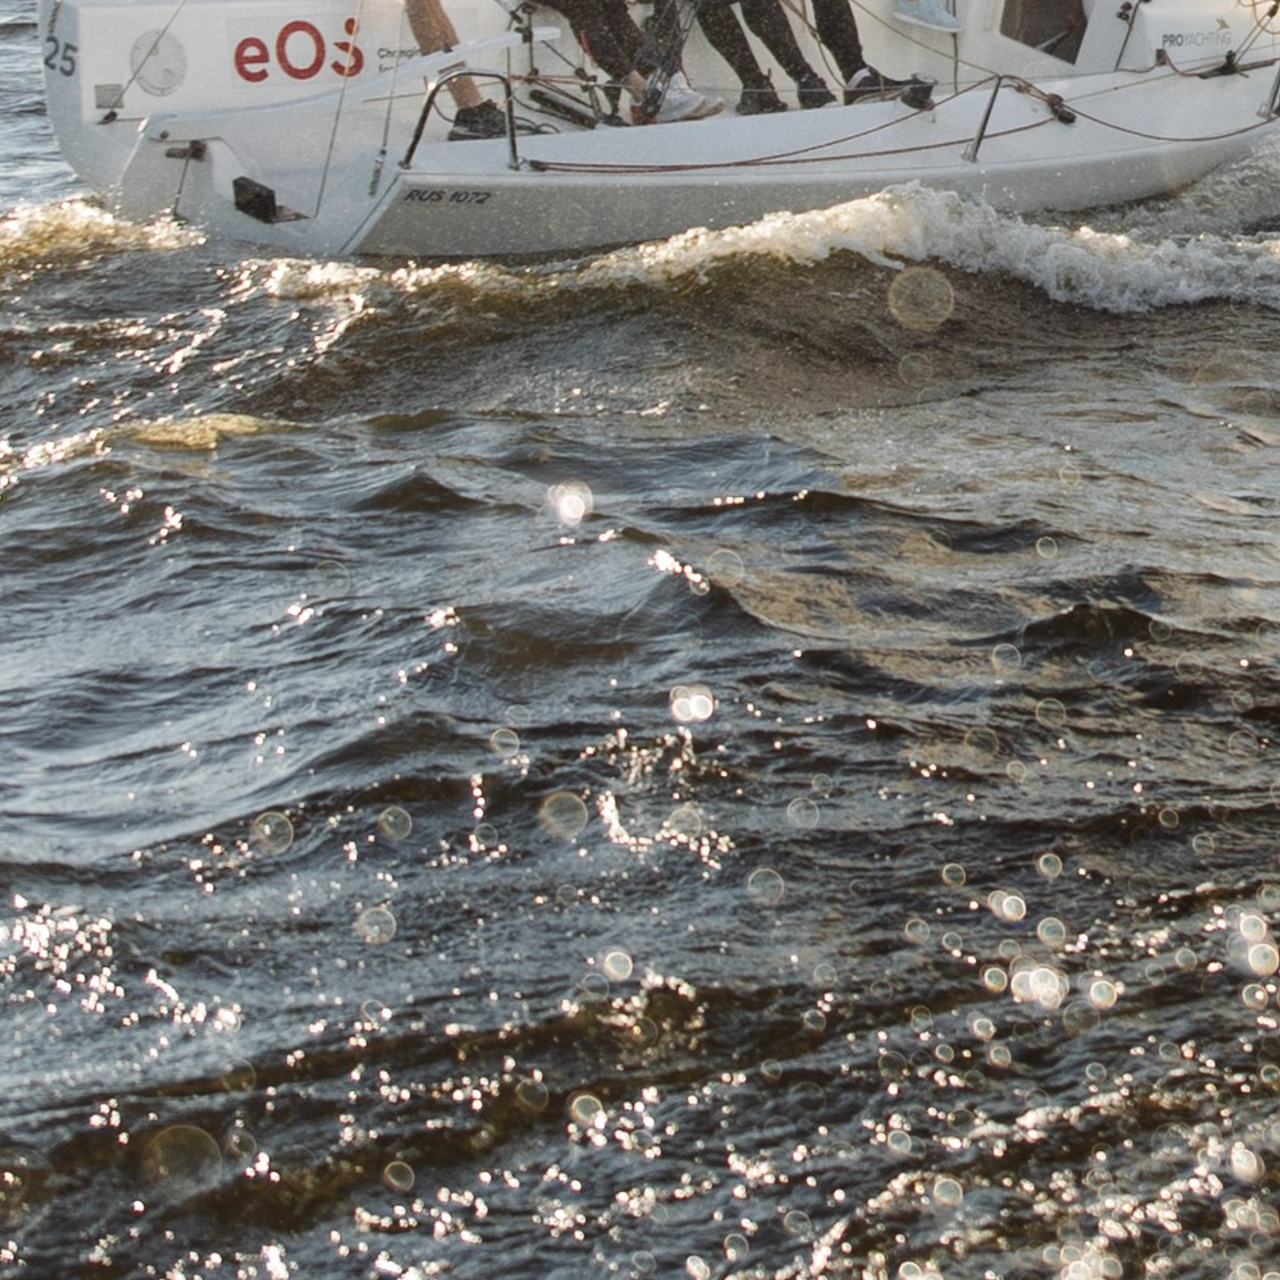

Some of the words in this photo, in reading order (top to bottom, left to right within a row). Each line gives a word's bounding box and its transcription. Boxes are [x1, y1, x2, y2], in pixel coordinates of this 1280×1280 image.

[44, 35, 77, 77] 25
[404, 189, 446, 201] RUS
[449, 191, 492, 204] 1072
